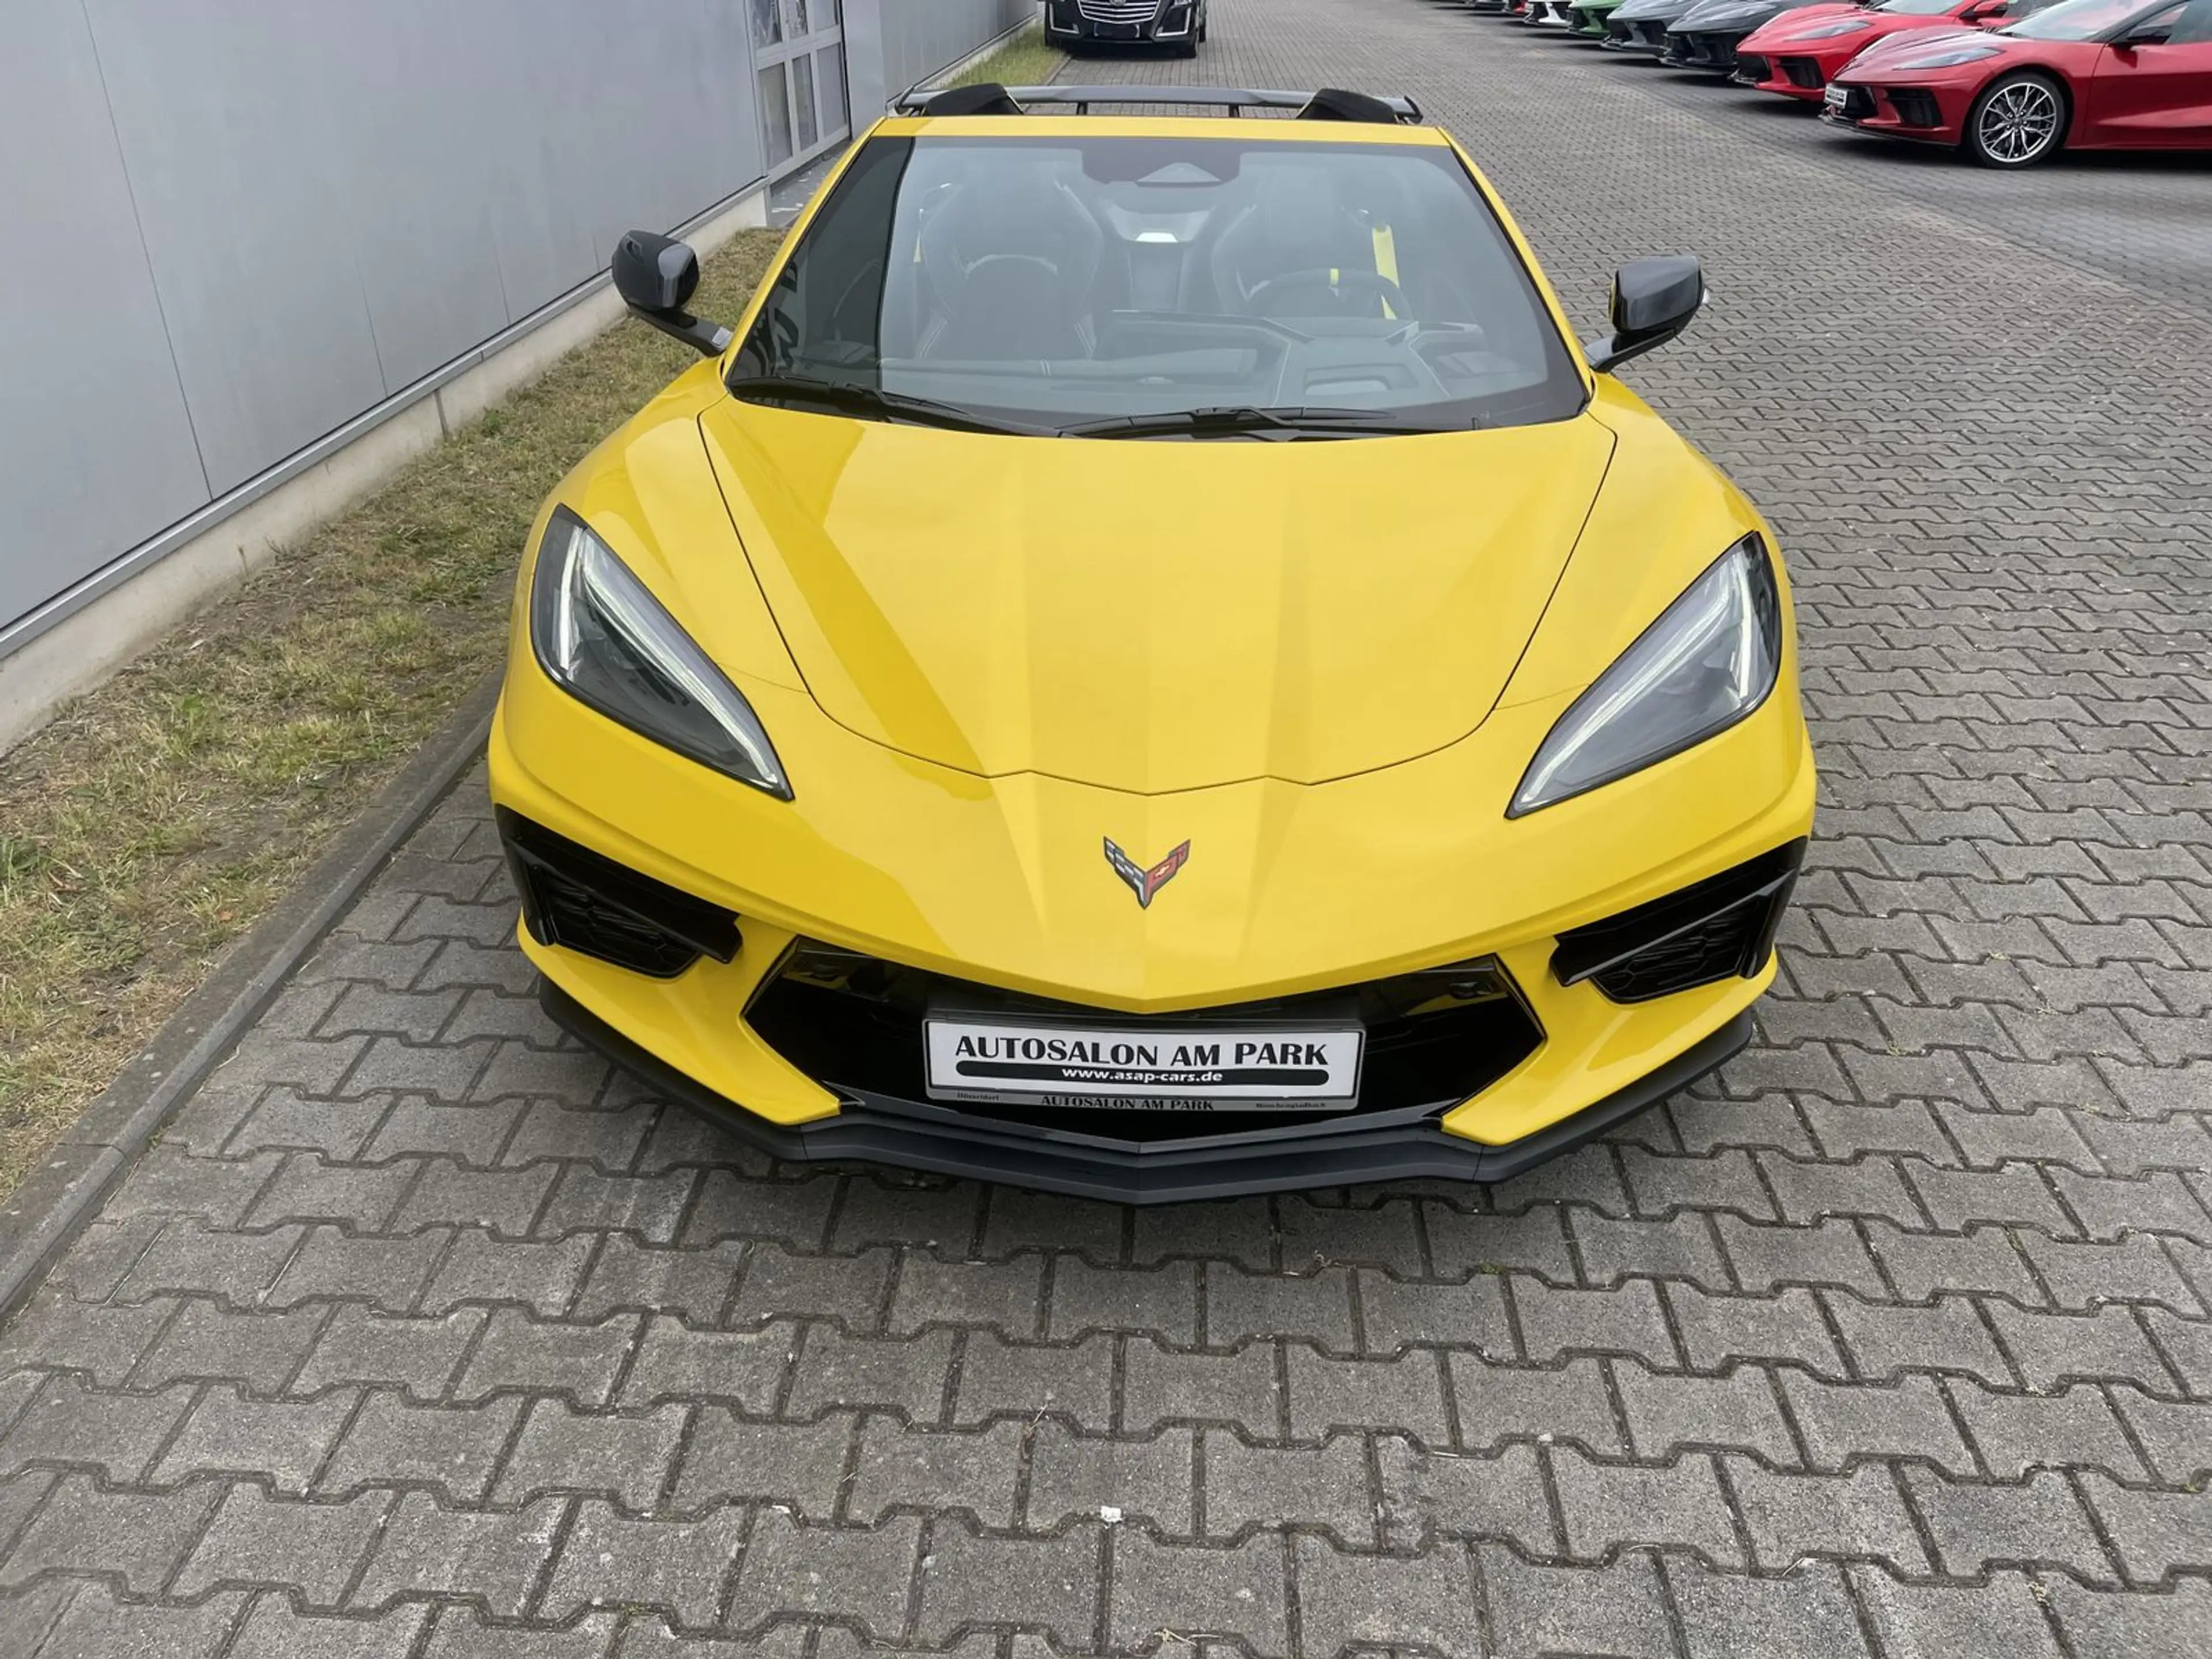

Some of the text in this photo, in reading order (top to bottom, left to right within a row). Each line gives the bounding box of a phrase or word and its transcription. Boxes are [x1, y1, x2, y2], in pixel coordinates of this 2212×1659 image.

[955, 1035, 1328, 1067] AUTOSALON AM PARK
[1062, 1067, 1223, 1084] www.asap-cars.de
[1041, 1096, 1214, 1111] AUTOSALON AM PARK
